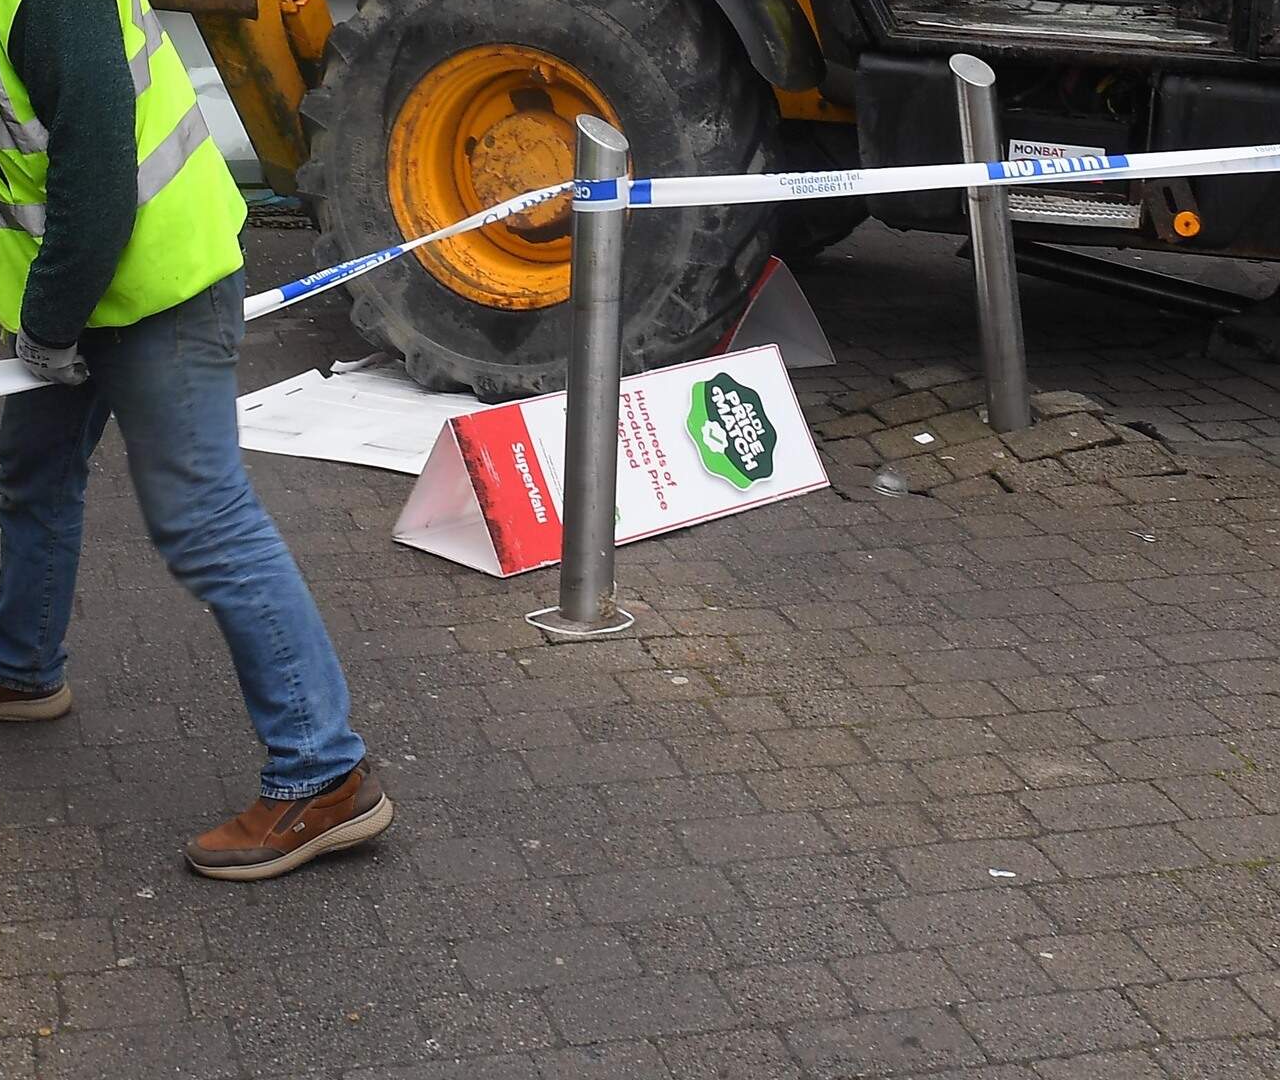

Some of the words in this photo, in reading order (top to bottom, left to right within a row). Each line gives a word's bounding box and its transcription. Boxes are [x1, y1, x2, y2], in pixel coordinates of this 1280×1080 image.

[779, 173, 842, 186] Confidential
[1014, 143, 1067, 158] MONBAT
[790, 181, 854, 195] 1800-666111
[620, 393, 652, 466] Products
[647, 469, 669, 511] Price
[633, 389, 667, 468] Hundreds
[663, 471, 678, 488] of
[711, 386, 759, 472] MATCH
[724, 390, 765, 457] PRICE
[742, 402, 766, 436] ALDI
[511, 441, 549, 525] SuperValu
